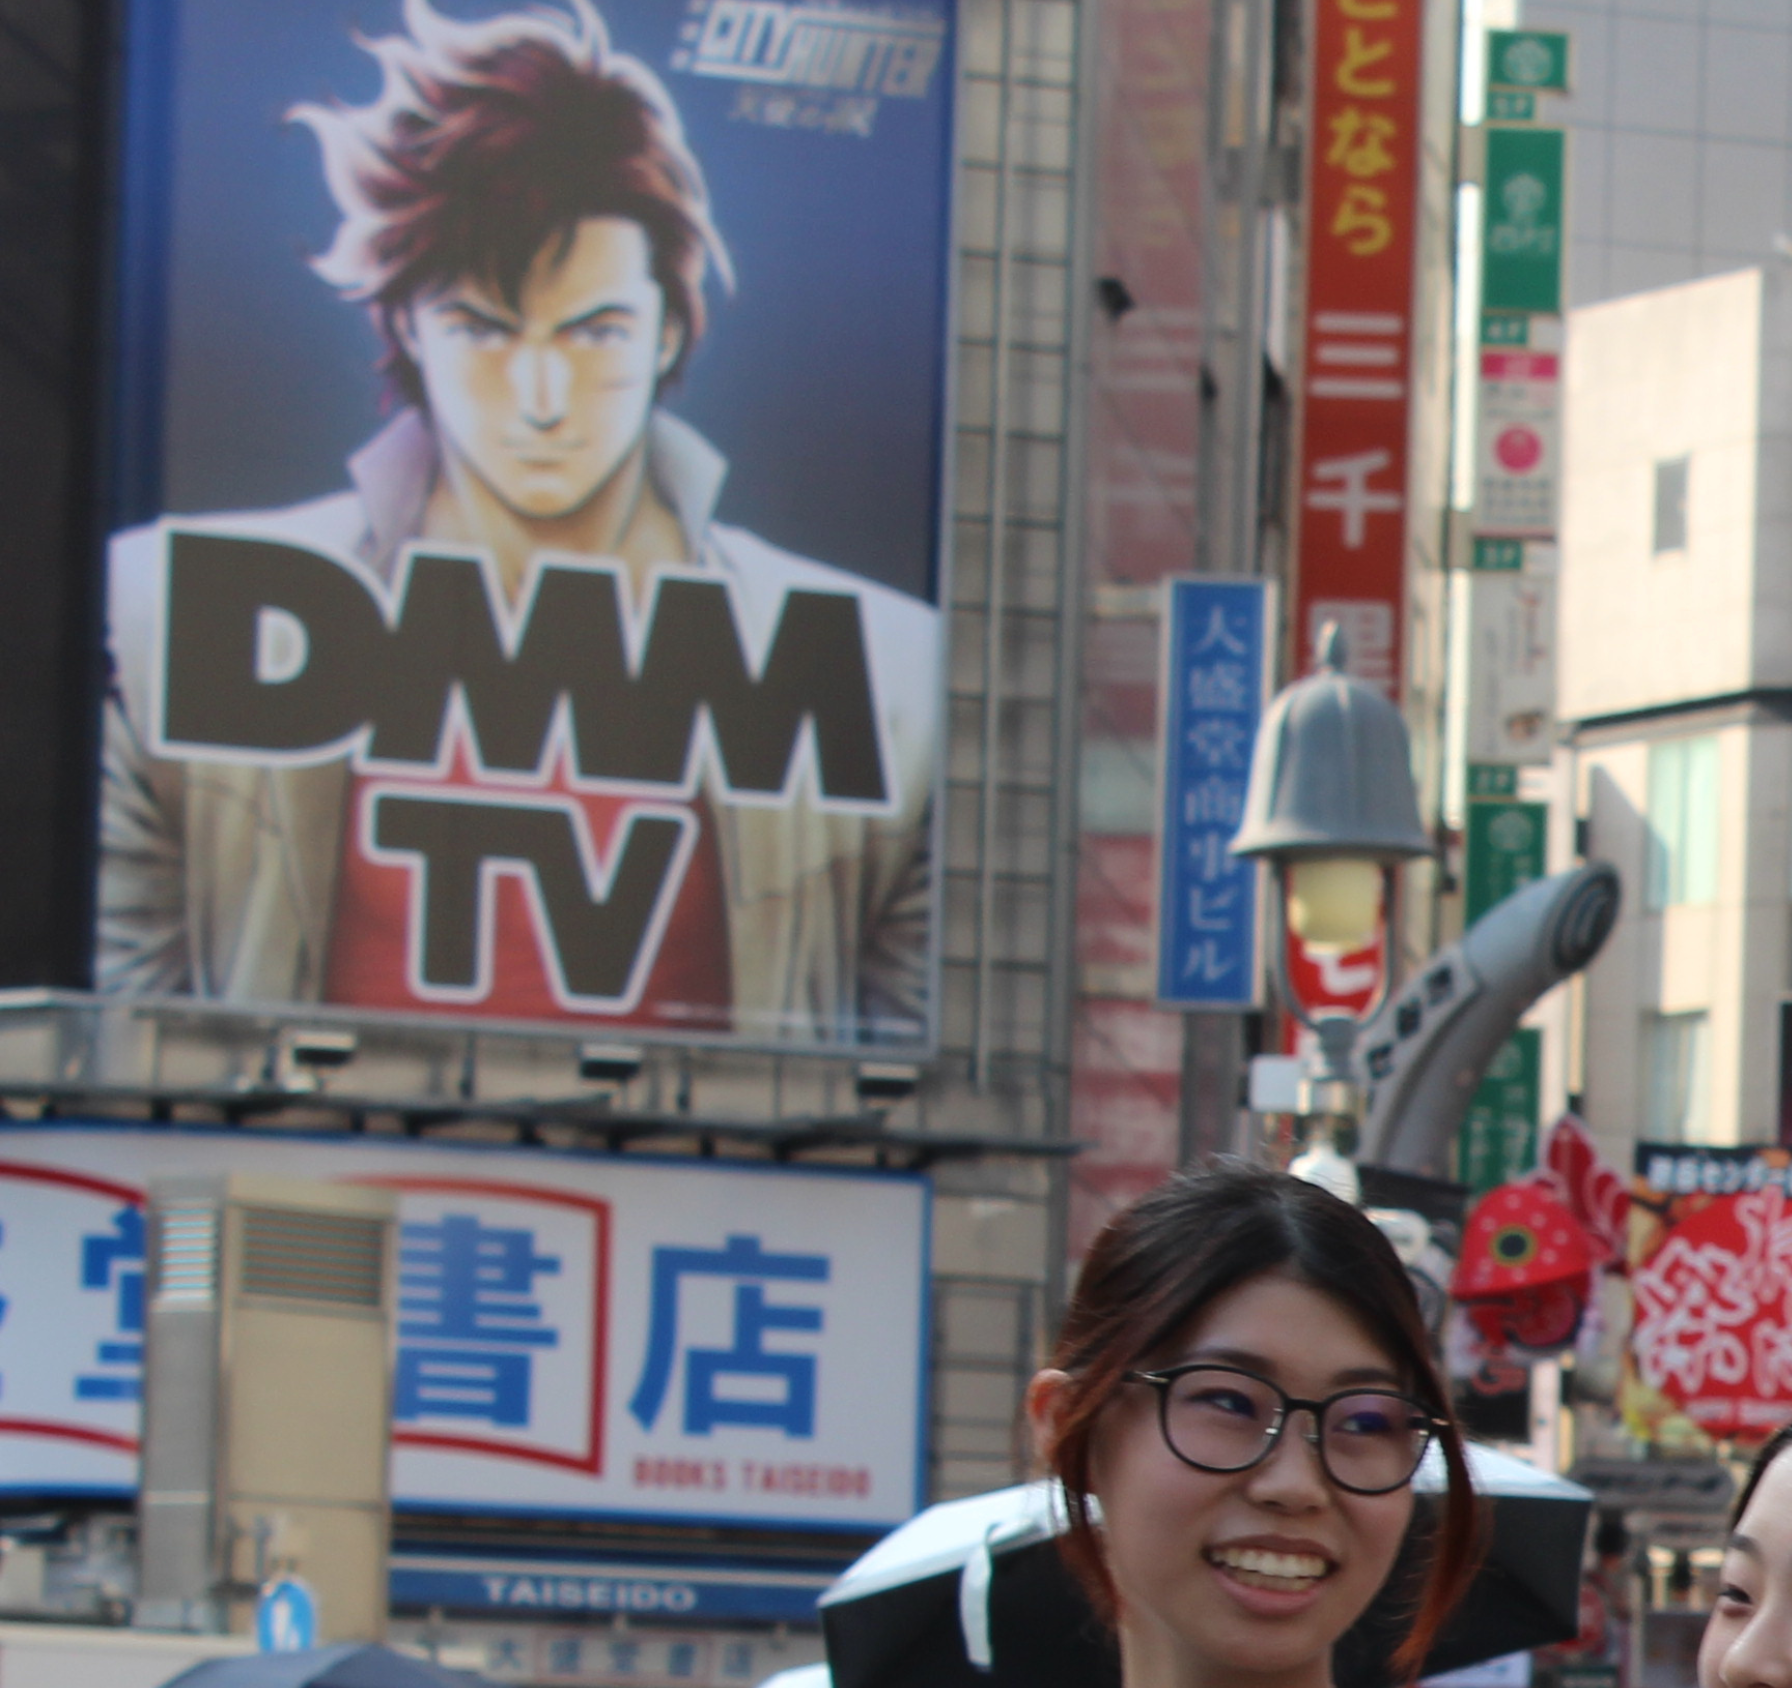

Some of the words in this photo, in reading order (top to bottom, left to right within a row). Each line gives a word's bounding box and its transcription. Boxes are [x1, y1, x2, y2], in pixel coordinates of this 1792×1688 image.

[1328, 0, 1398, 256] となら
[160, 528, 892, 802] DMM
[375, 801, 692, 1001] TV
[632, 1455, 728, 1494] BOOKS
[740, 1463, 873, 1499] TAISEIDO
[483, 1576, 697, 1613] TAISEIDO
